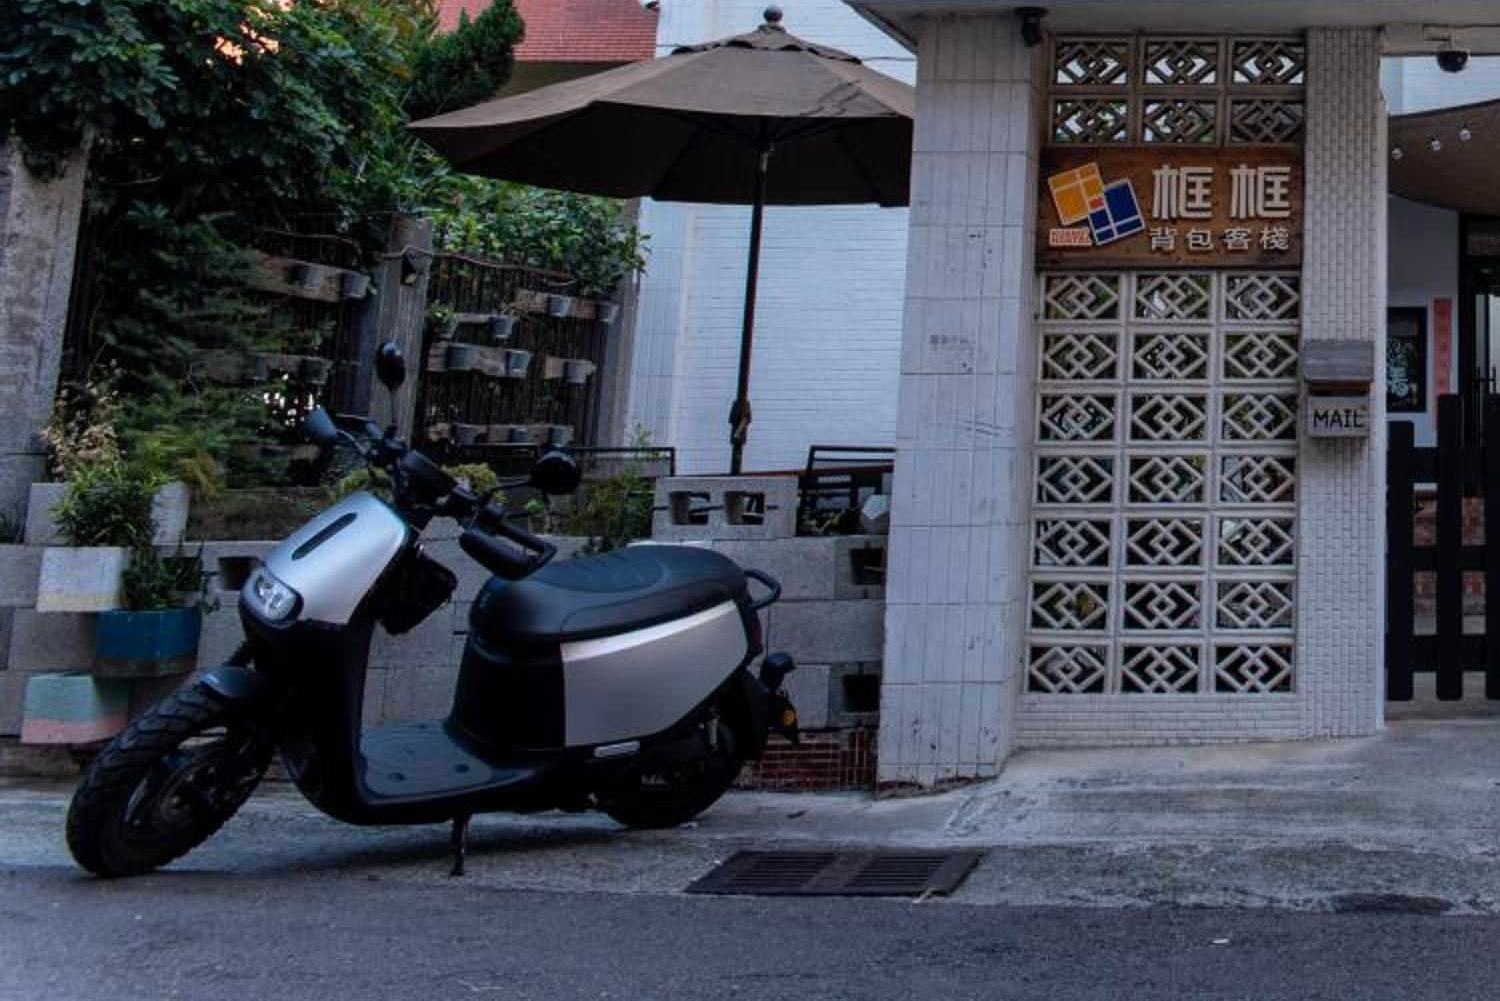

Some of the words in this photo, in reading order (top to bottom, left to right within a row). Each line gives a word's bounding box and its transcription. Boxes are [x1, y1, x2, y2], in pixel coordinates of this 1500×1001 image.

[1151, 164, 1292, 220] 框框
[1149, 227, 1290, 251] 背包客棧
[1312, 408, 1365, 429] MAIL
